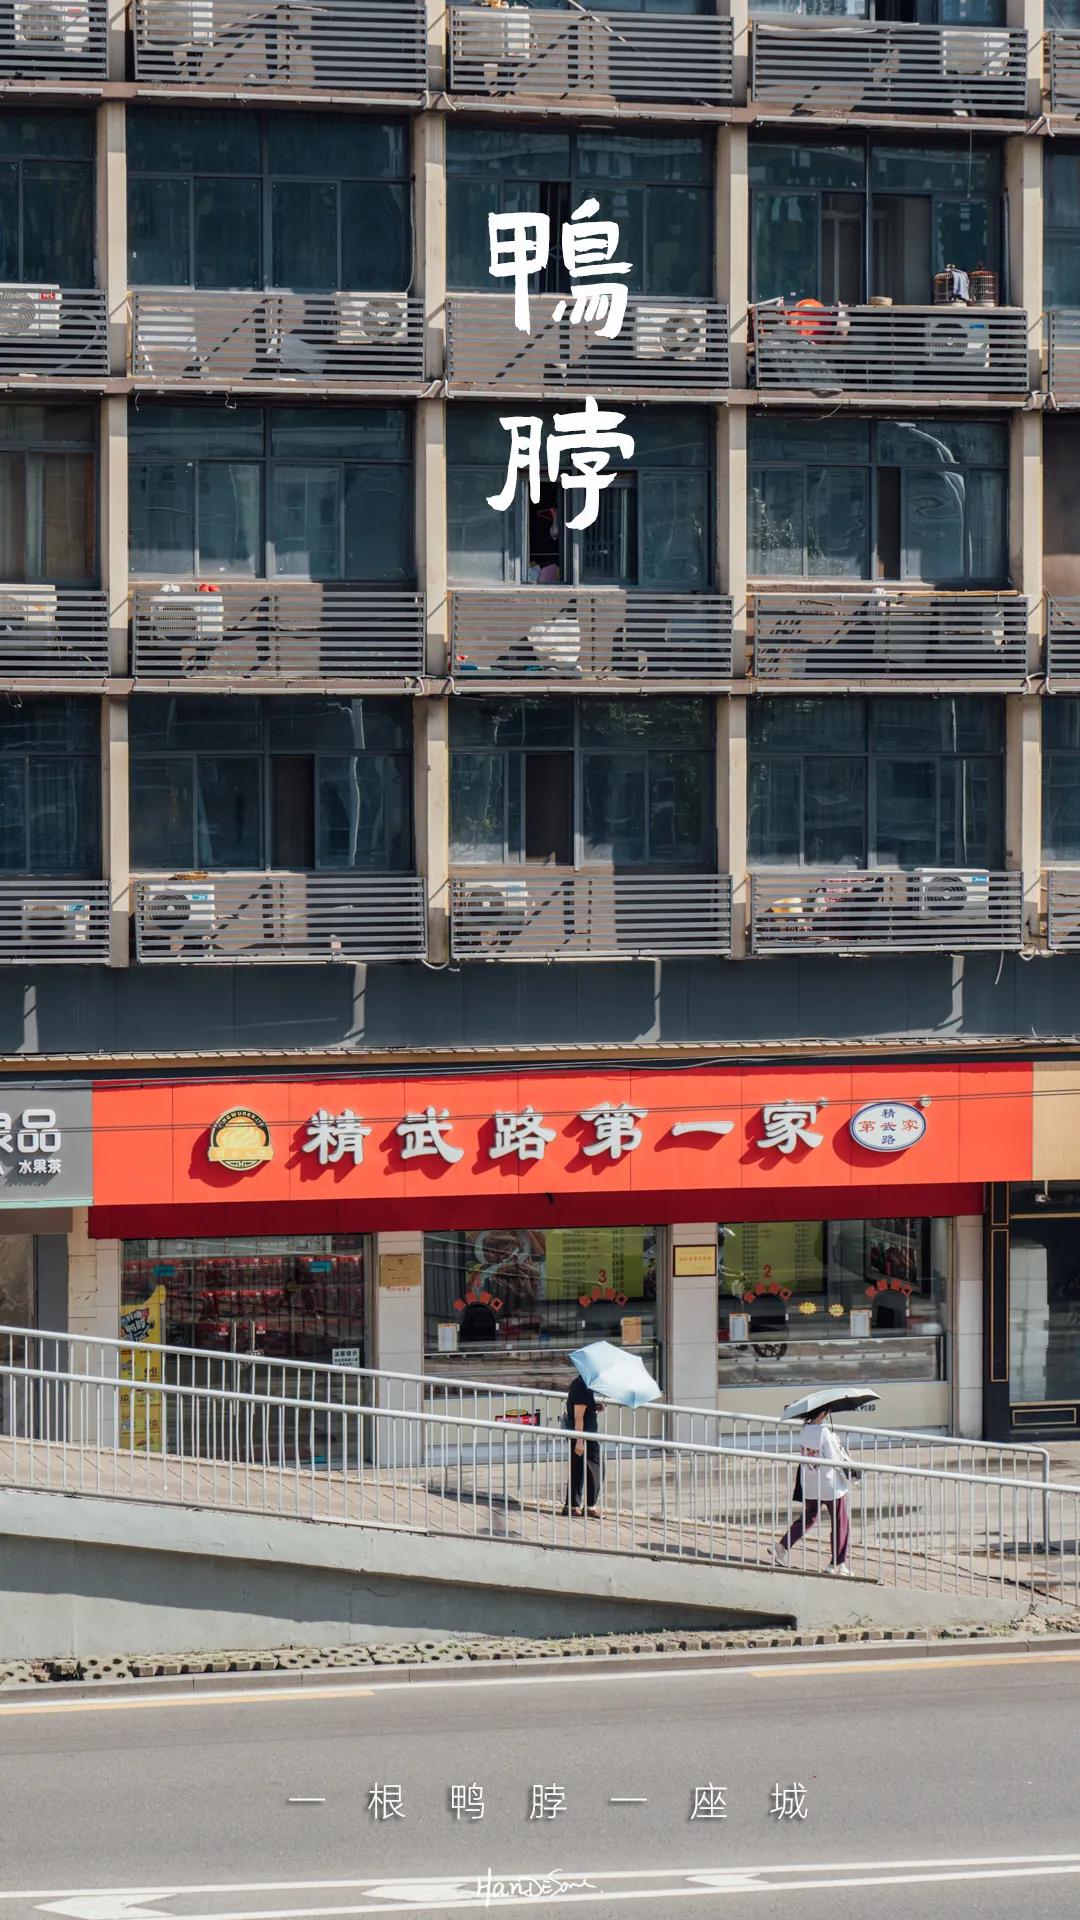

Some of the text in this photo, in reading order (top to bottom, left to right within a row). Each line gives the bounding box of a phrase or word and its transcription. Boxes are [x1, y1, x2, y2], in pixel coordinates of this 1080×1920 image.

[302, 1100, 823, 1165] 精武路第一家
[19, 1159, 61, 1174] 水果茶
[598, 1269, 607, 1283] 3
[763, 1264, 772, 1279] 2
